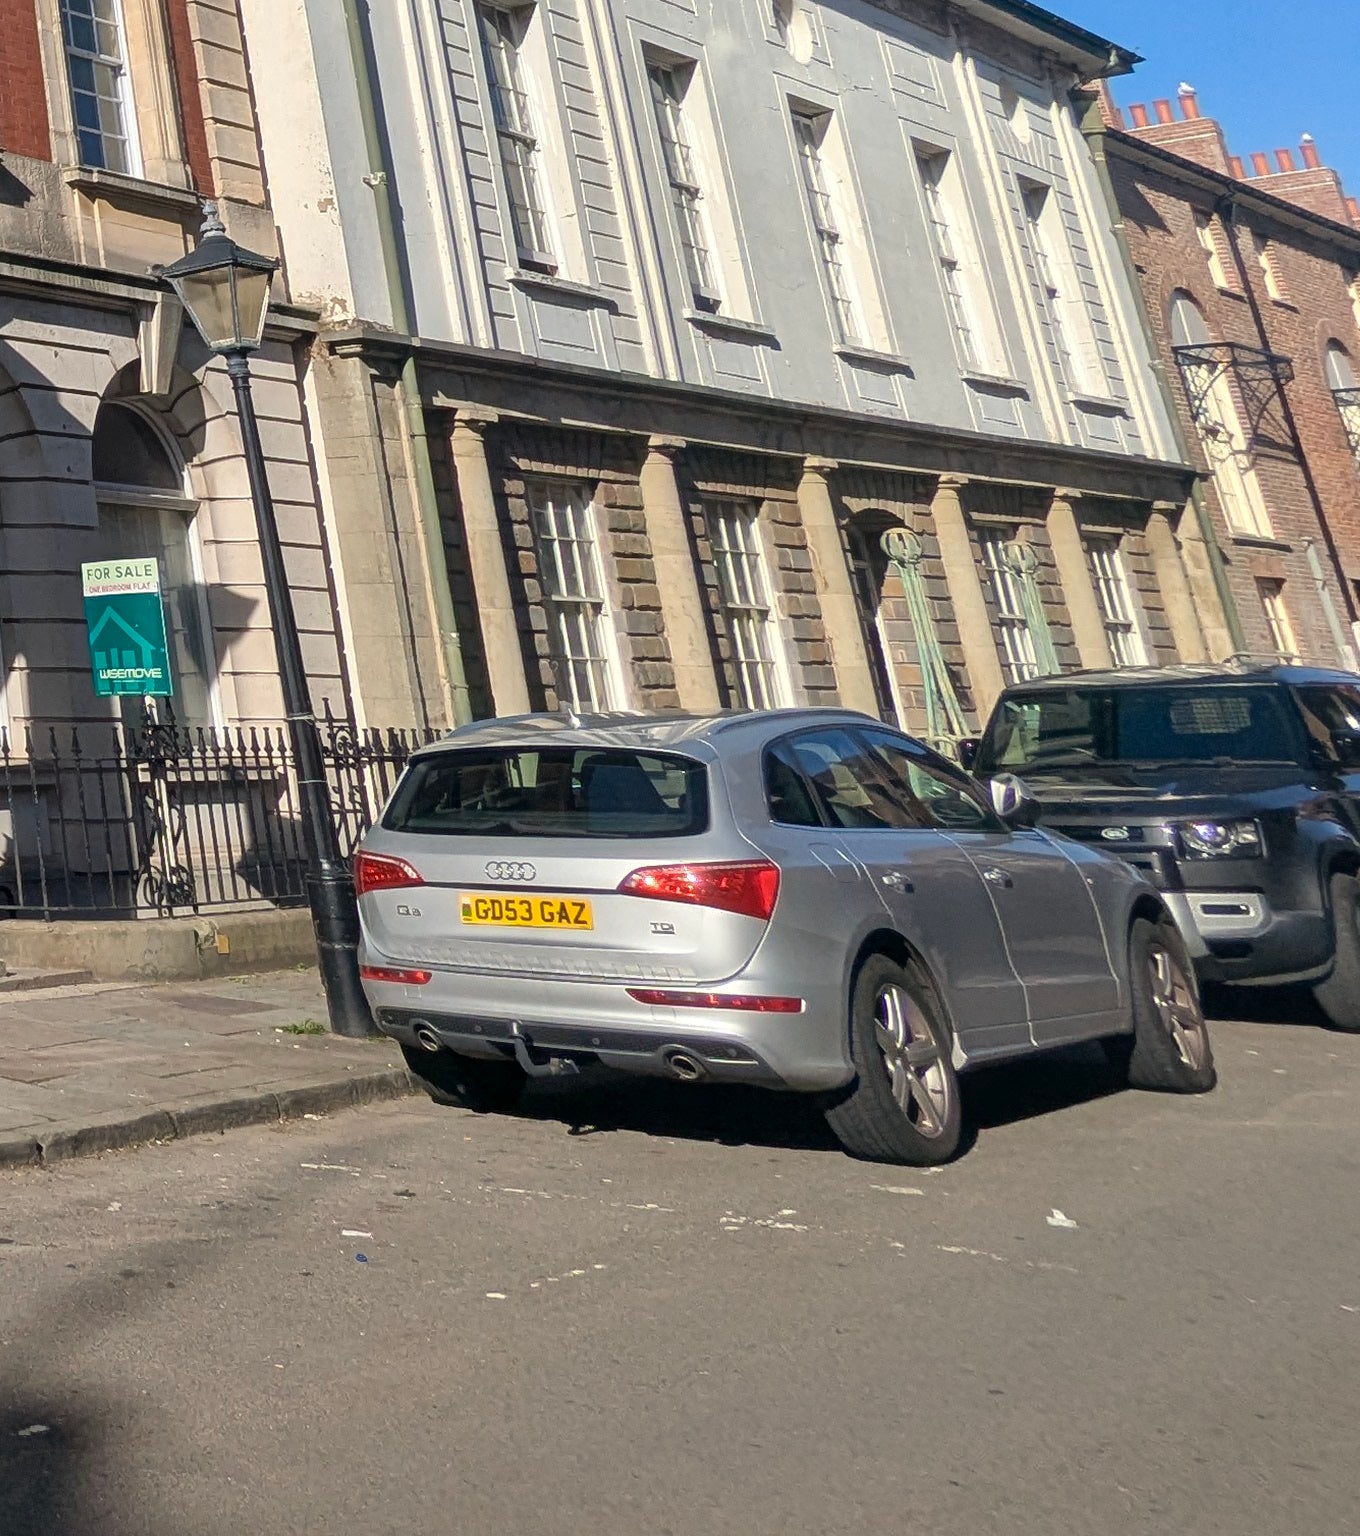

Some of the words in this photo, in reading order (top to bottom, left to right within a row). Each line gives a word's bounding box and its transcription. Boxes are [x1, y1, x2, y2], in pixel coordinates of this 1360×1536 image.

[86, 567, 111, 580] FOR
[115, 564, 153, 578] SALE
[133, 582, 151, 590] FLAT
[474, 898, 533, 922] GD53
[540, 900, 588, 925] GAZ
[649, 922, 675, 931] TDI
